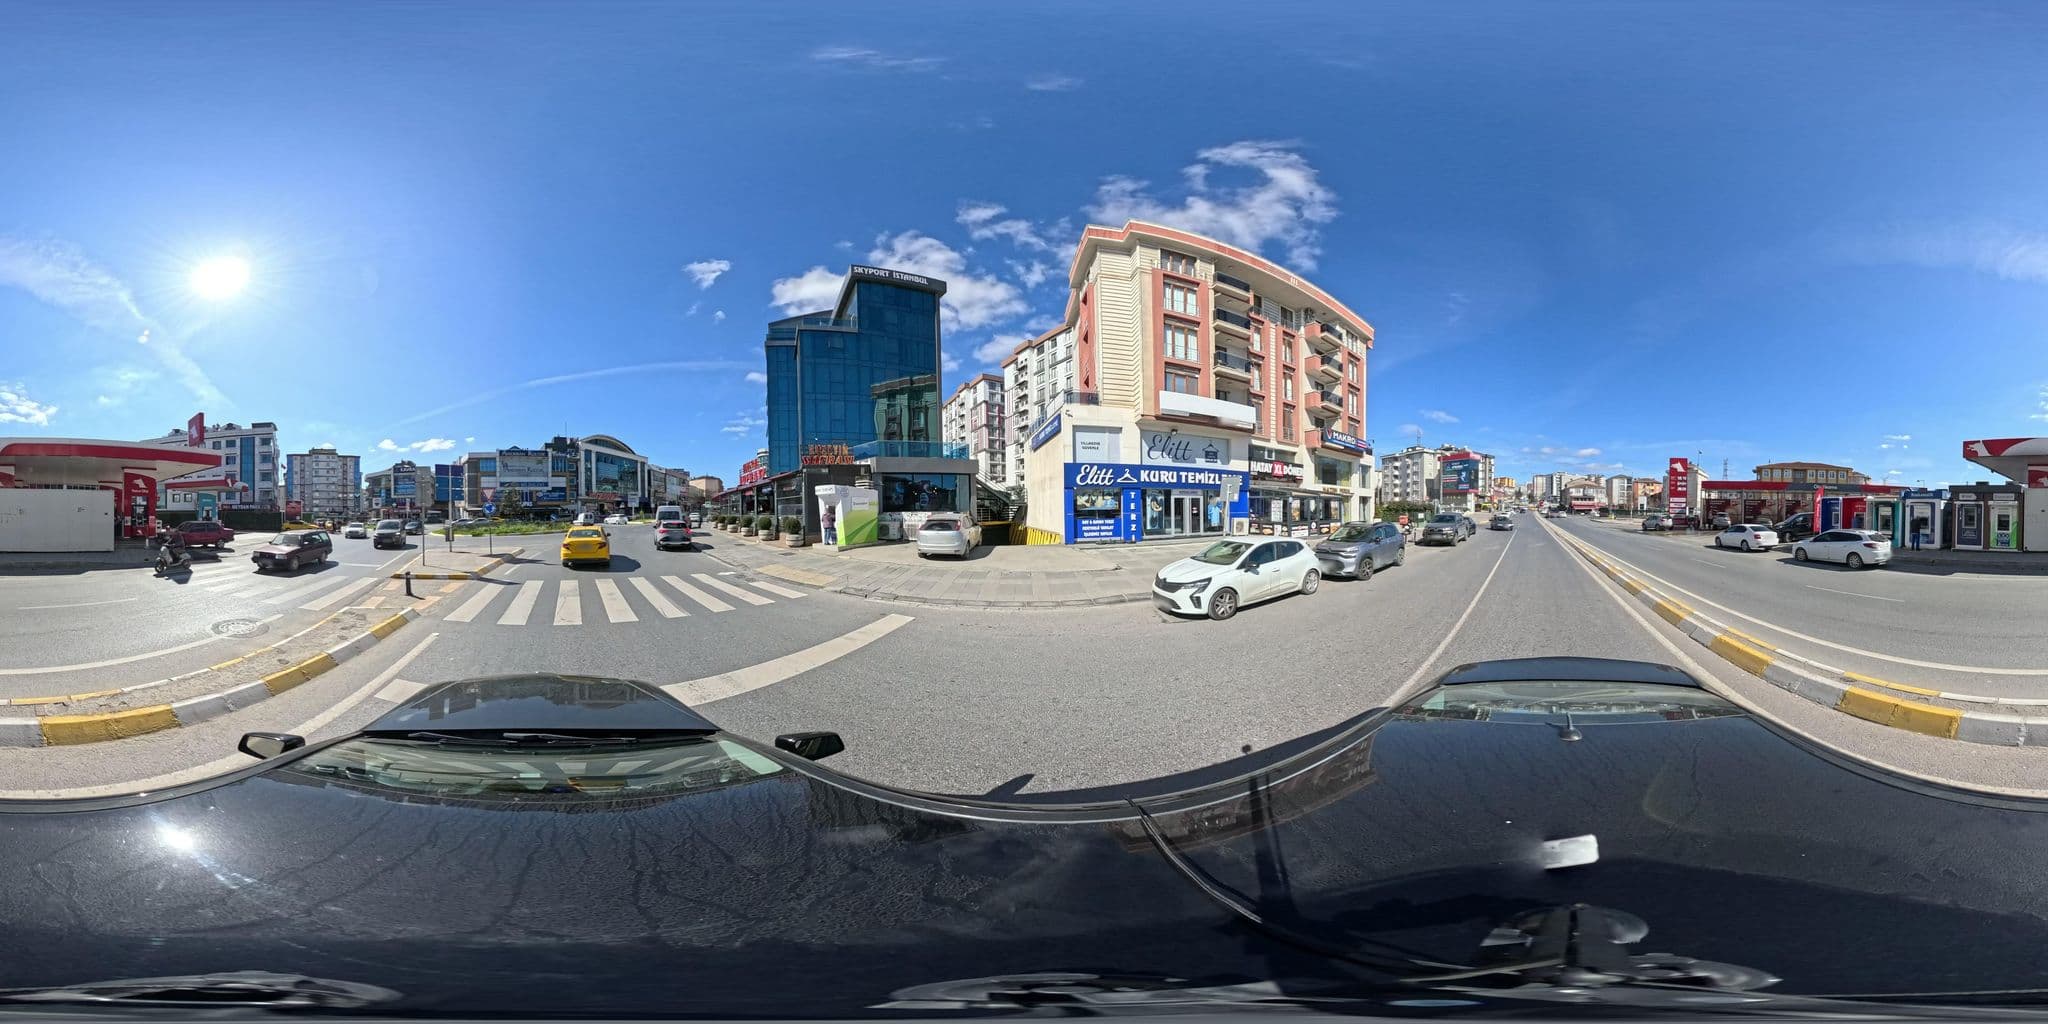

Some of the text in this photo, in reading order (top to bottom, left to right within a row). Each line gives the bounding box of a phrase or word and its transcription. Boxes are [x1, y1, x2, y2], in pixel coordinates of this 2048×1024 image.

[853, 266, 889, 278] SKYPORT
[1147, 434, 1192, 460] Elitt
[1076, 465, 1114, 486] Elitt
[1140, 470, 1177, 483] KURU
[1250, 461, 1273, 474] HATAY
[1274, 463, 1282, 474] XL
